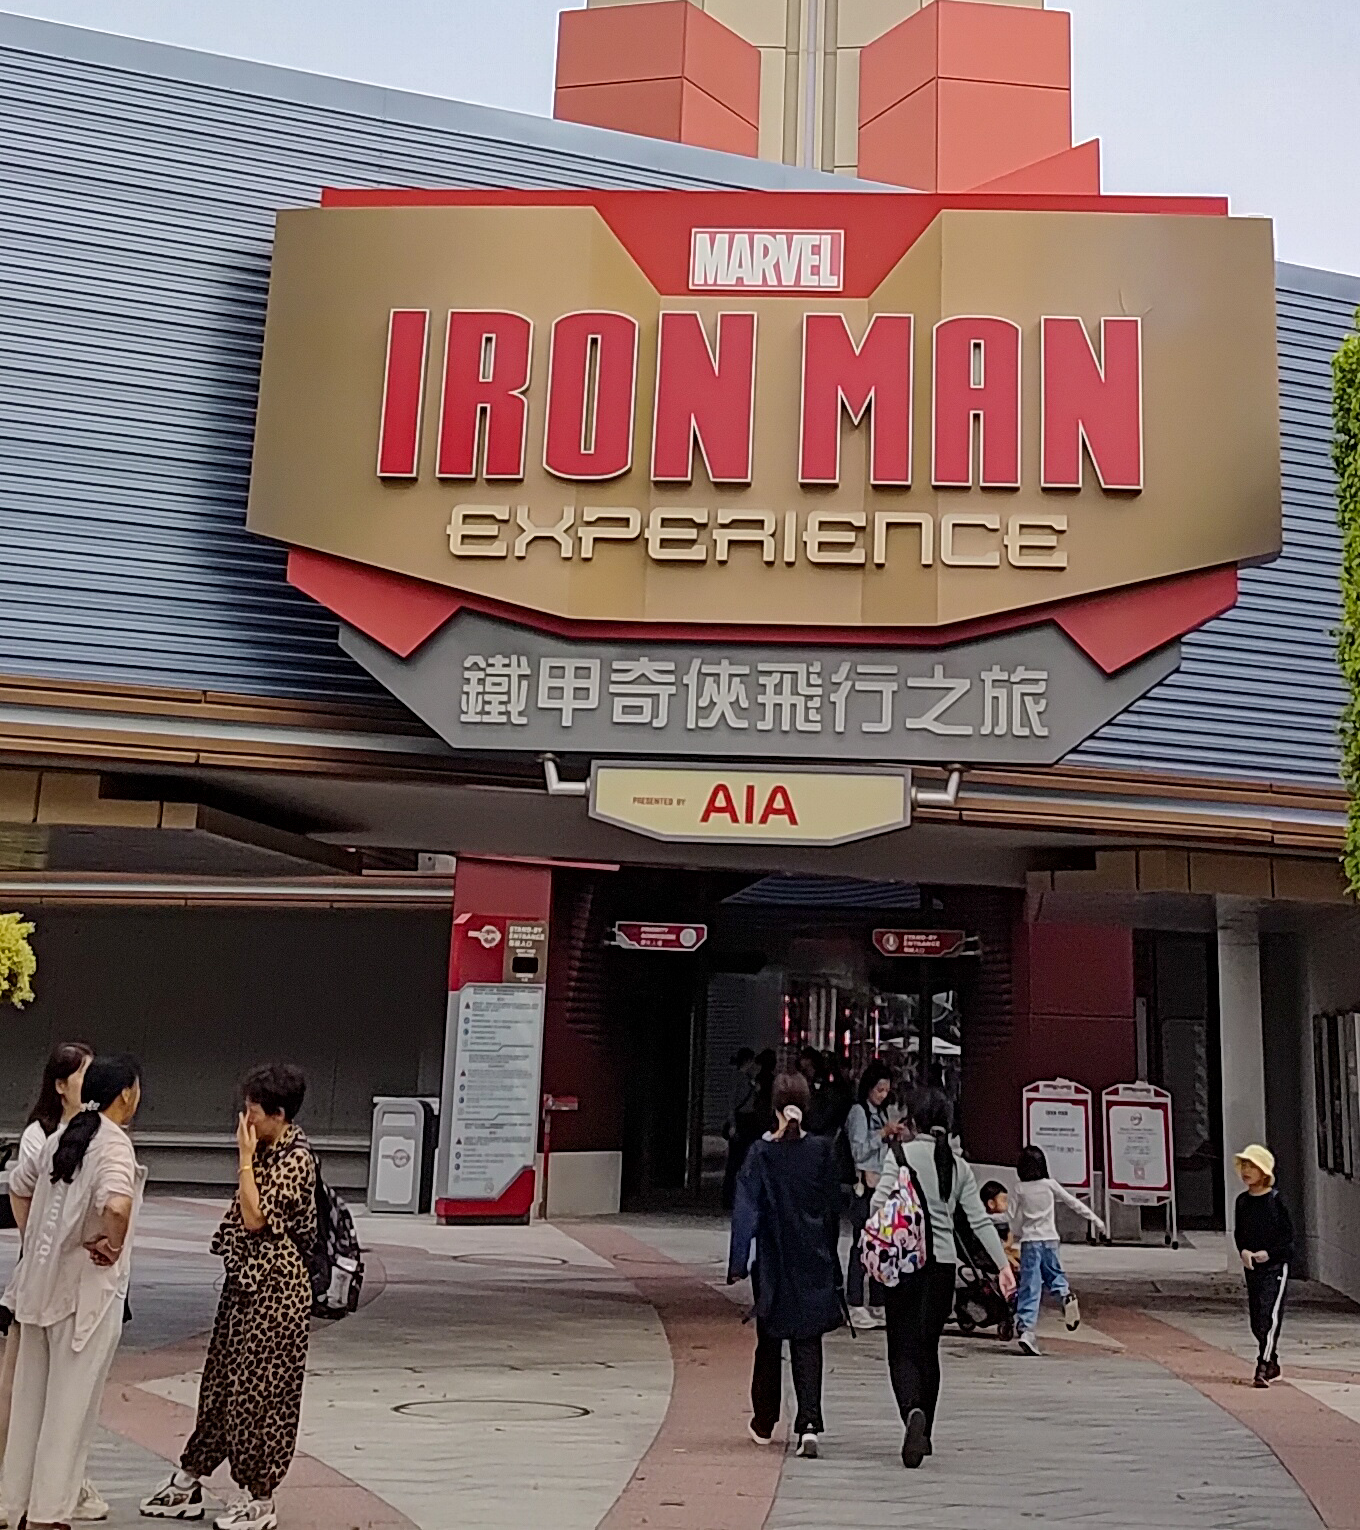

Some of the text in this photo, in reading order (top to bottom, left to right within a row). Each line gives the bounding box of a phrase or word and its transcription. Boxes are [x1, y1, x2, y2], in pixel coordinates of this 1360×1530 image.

[694, 233, 837, 287] MARVEL
[377, 308, 1143, 491] IRON MAN
[446, 503, 1068, 569] EXPERIENCE
[459, 654, 1050, 738] 鐵甲奇俠飛行之旅
[632, 783, 799, 827] PRESENTED BY AIA
